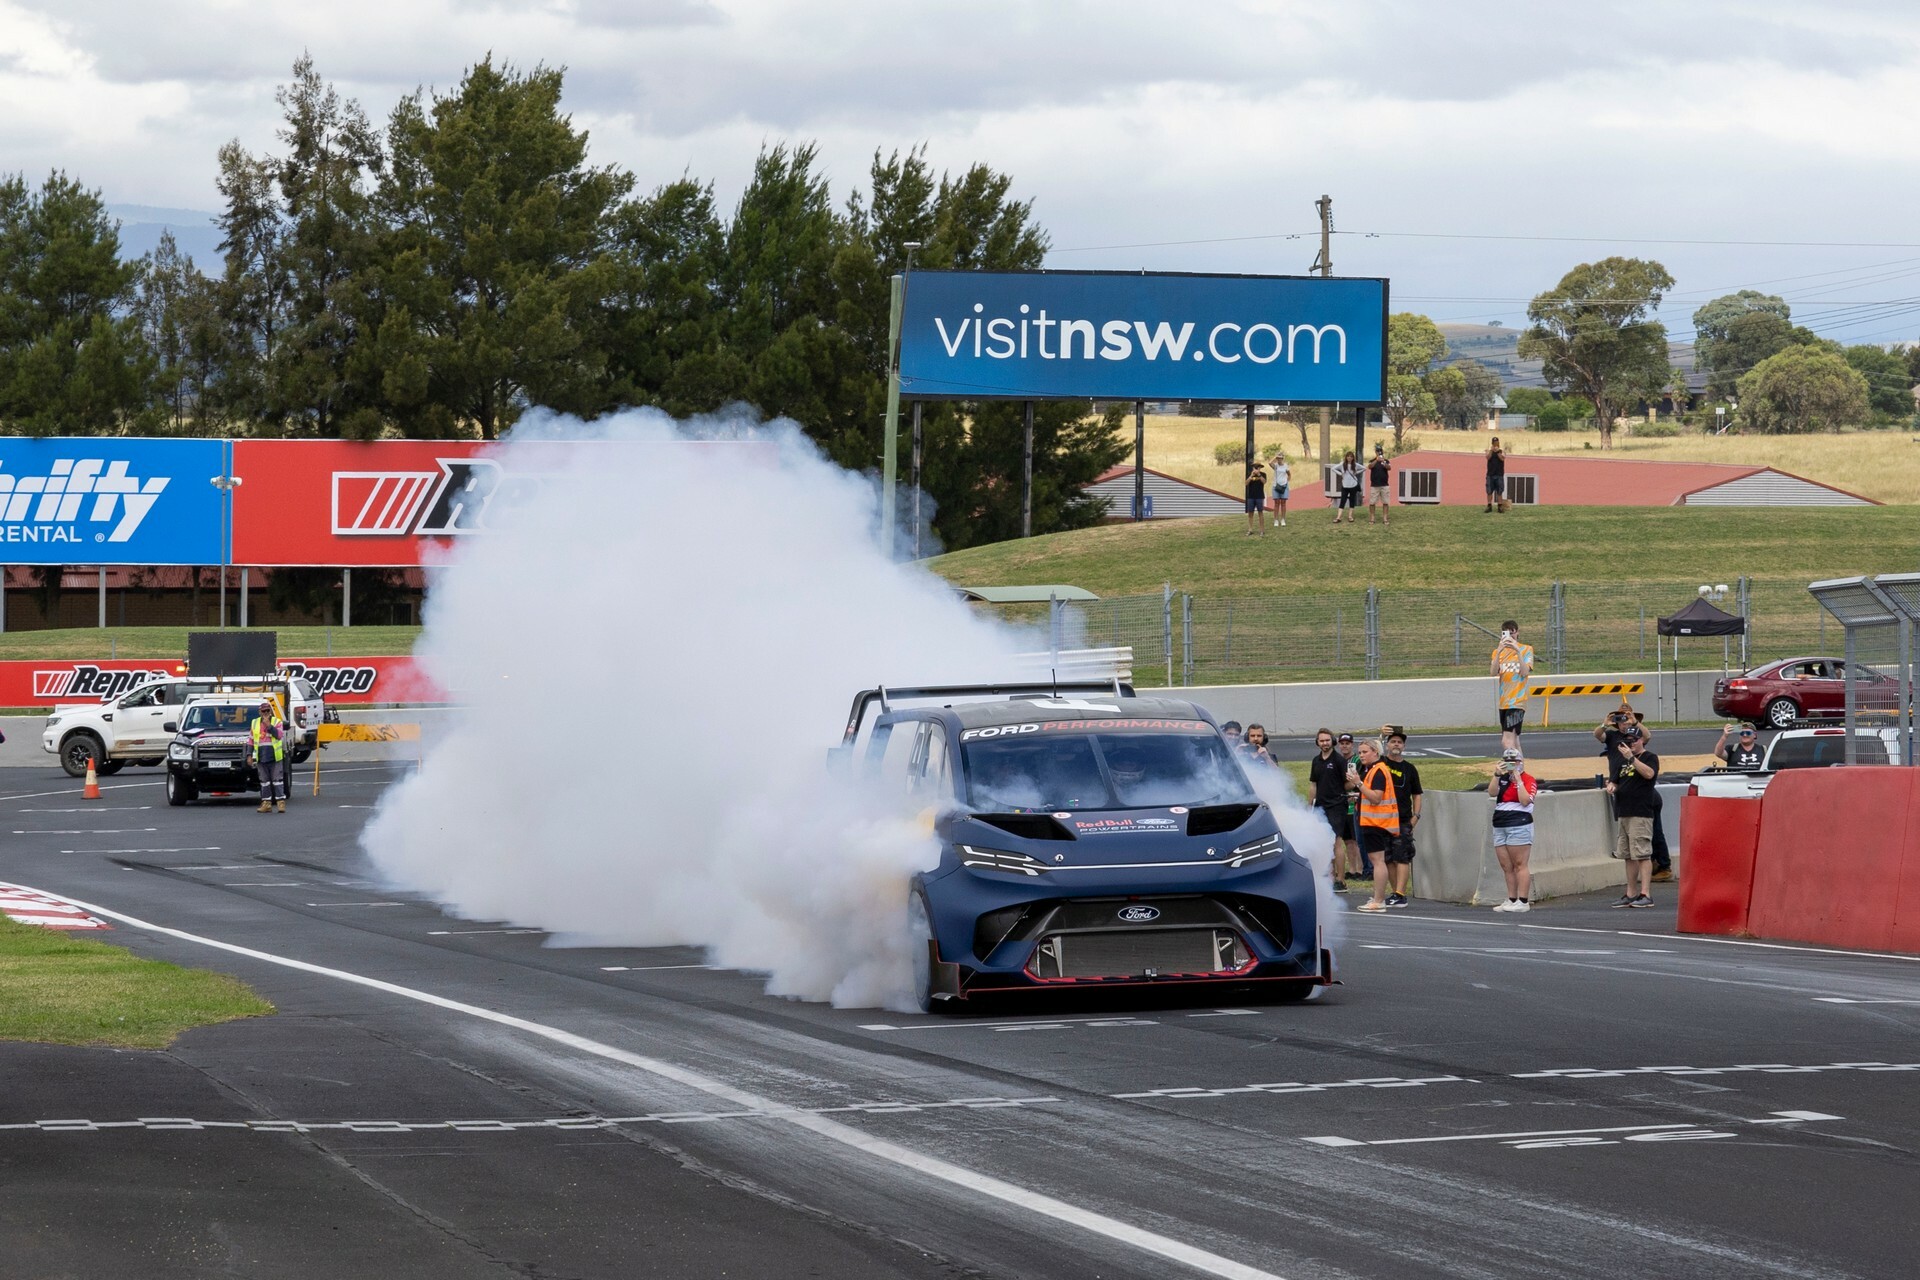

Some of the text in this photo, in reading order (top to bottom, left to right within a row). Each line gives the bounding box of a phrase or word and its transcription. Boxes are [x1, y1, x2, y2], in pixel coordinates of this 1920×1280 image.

[934, 302, 1347, 364] visitnsw.com
[0, 525, 83, 543] ENTAL
[68, 665, 165, 701] Repc
[962, 719, 1207, 741] FORD PERFORMANCE
[1075, 819, 1134, 829] Red Bull
[1079, 824, 1178, 832] POWERTRAINS
[1125, 907, 1153, 919] Ford
